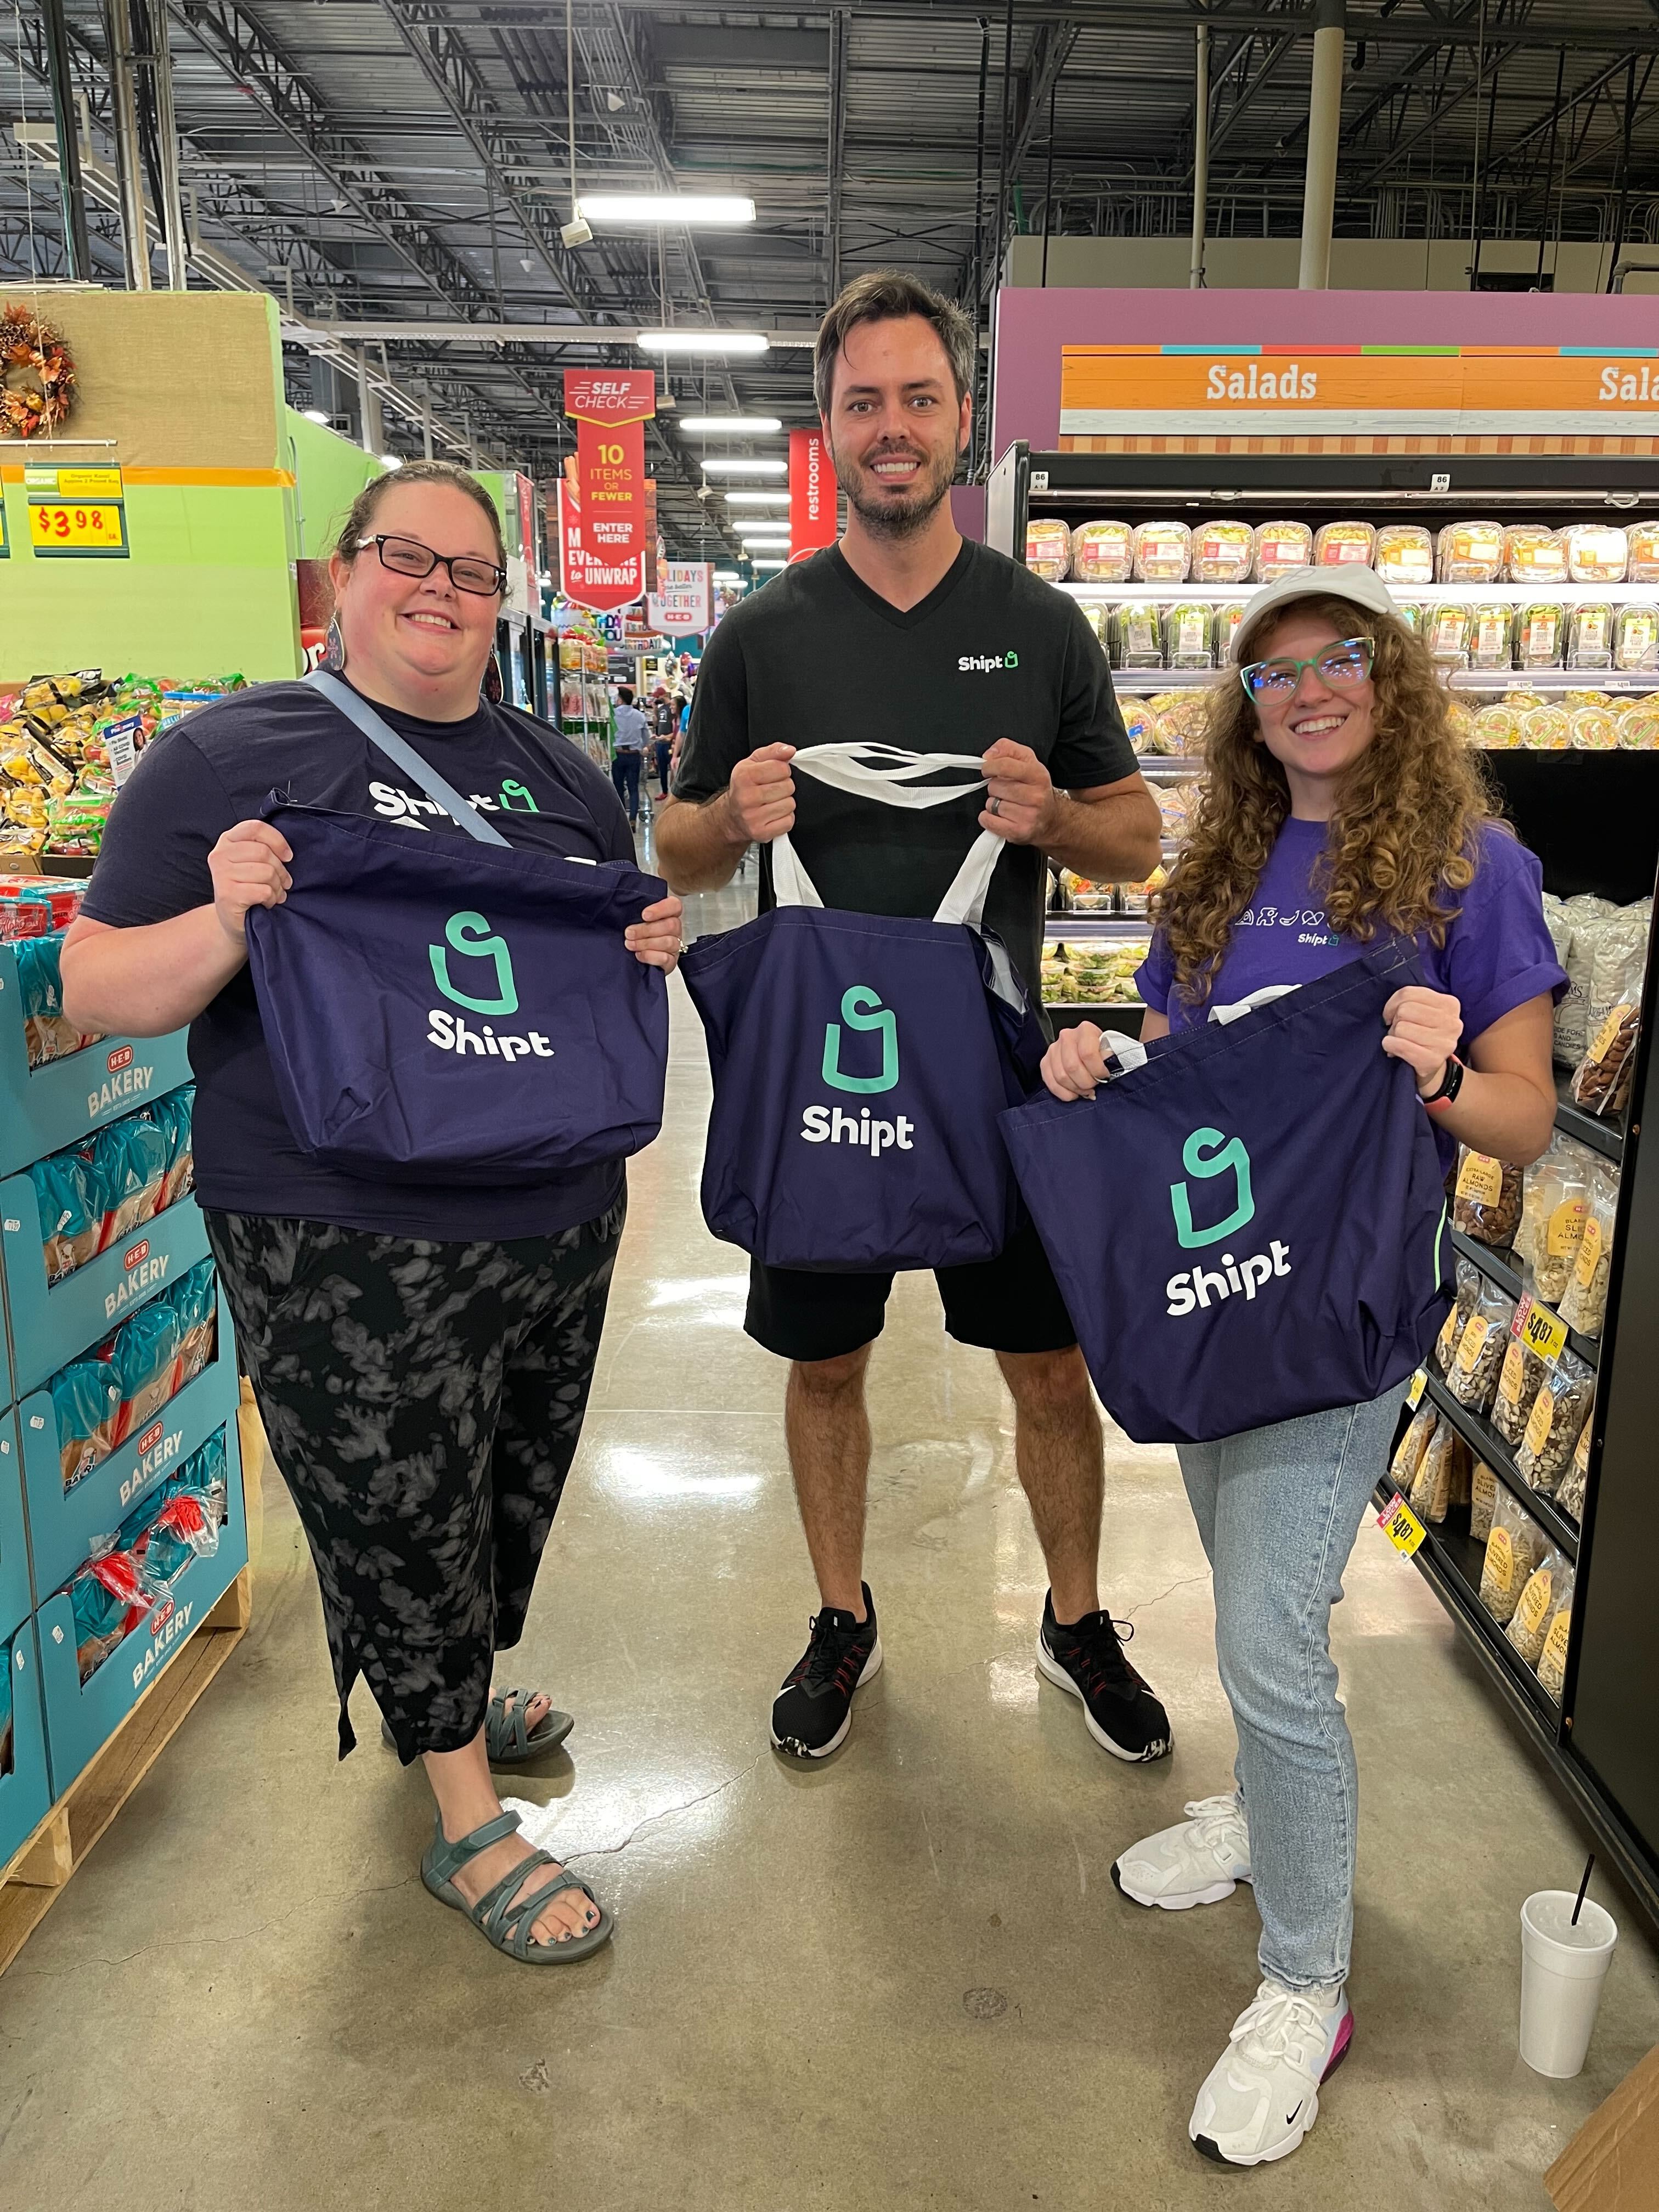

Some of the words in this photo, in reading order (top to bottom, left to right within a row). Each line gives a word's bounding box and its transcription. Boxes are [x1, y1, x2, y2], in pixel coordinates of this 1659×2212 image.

[591, 382, 631, 394] SELF
[1207, 364, 1317, 399] Salads
[575, 396, 628, 408] CHECK
[597, 444, 624, 465] 10
[590, 469, 633, 481] ITEMS
[806, 438, 819, 520] restrooms
[603, 482, 619, 490] OR
[591, 492, 633, 501] FEWER
[593, 523, 633, 532] ENTER
[597, 534, 630, 543] HERE
[571, 569, 583, 582] to
[585, 567, 637, 585] UNWRAP
[667, 569, 703, 582] LIDAYS
[958, 656, 1003, 673] Shipt
[369, 781, 500, 826] Shit
[1298, 933, 1328, 946] Shipt
[426, 1009, 555, 1062] Shipt
[88, 1066, 154, 1119] BAKERY
[800, 1105, 914, 1156] Shipt
[1463, 1177, 1493, 1192] ALMONDS
[1472, 1173, 1485, 1182] RAW
[105, 1254, 170, 1319] BAKERY
[1166, 1240, 1291, 1316] Shipt
[1515, 1298, 1526, 1323] LOW
[120, 1430, 183, 1507] BAKERY
[1381, 1498, 1402, 1525] PRICES
[1383, 1498, 1396, 1517] LOW
[132, 1600, 194, 1690] BAKERY
